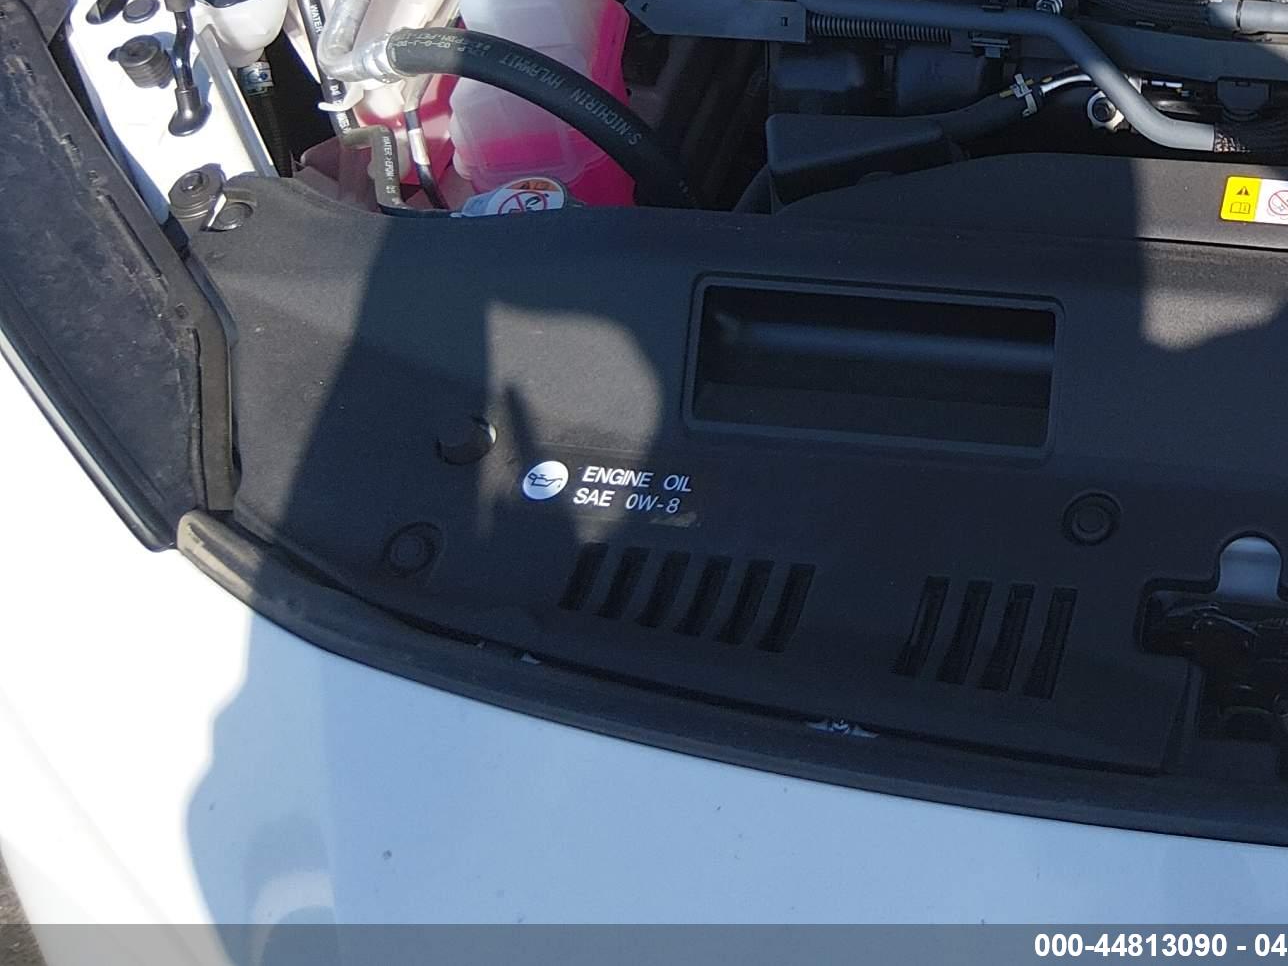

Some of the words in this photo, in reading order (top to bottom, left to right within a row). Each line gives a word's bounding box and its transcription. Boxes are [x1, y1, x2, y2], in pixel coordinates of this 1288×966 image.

[310, 3, 323, 34] WATER
[582, 465, 654, 488] ENGINE
[663, 474, 692, 493] OIL
[573, 487, 615, 507] SAE
[625, 493, 681, 514] 0W-8
